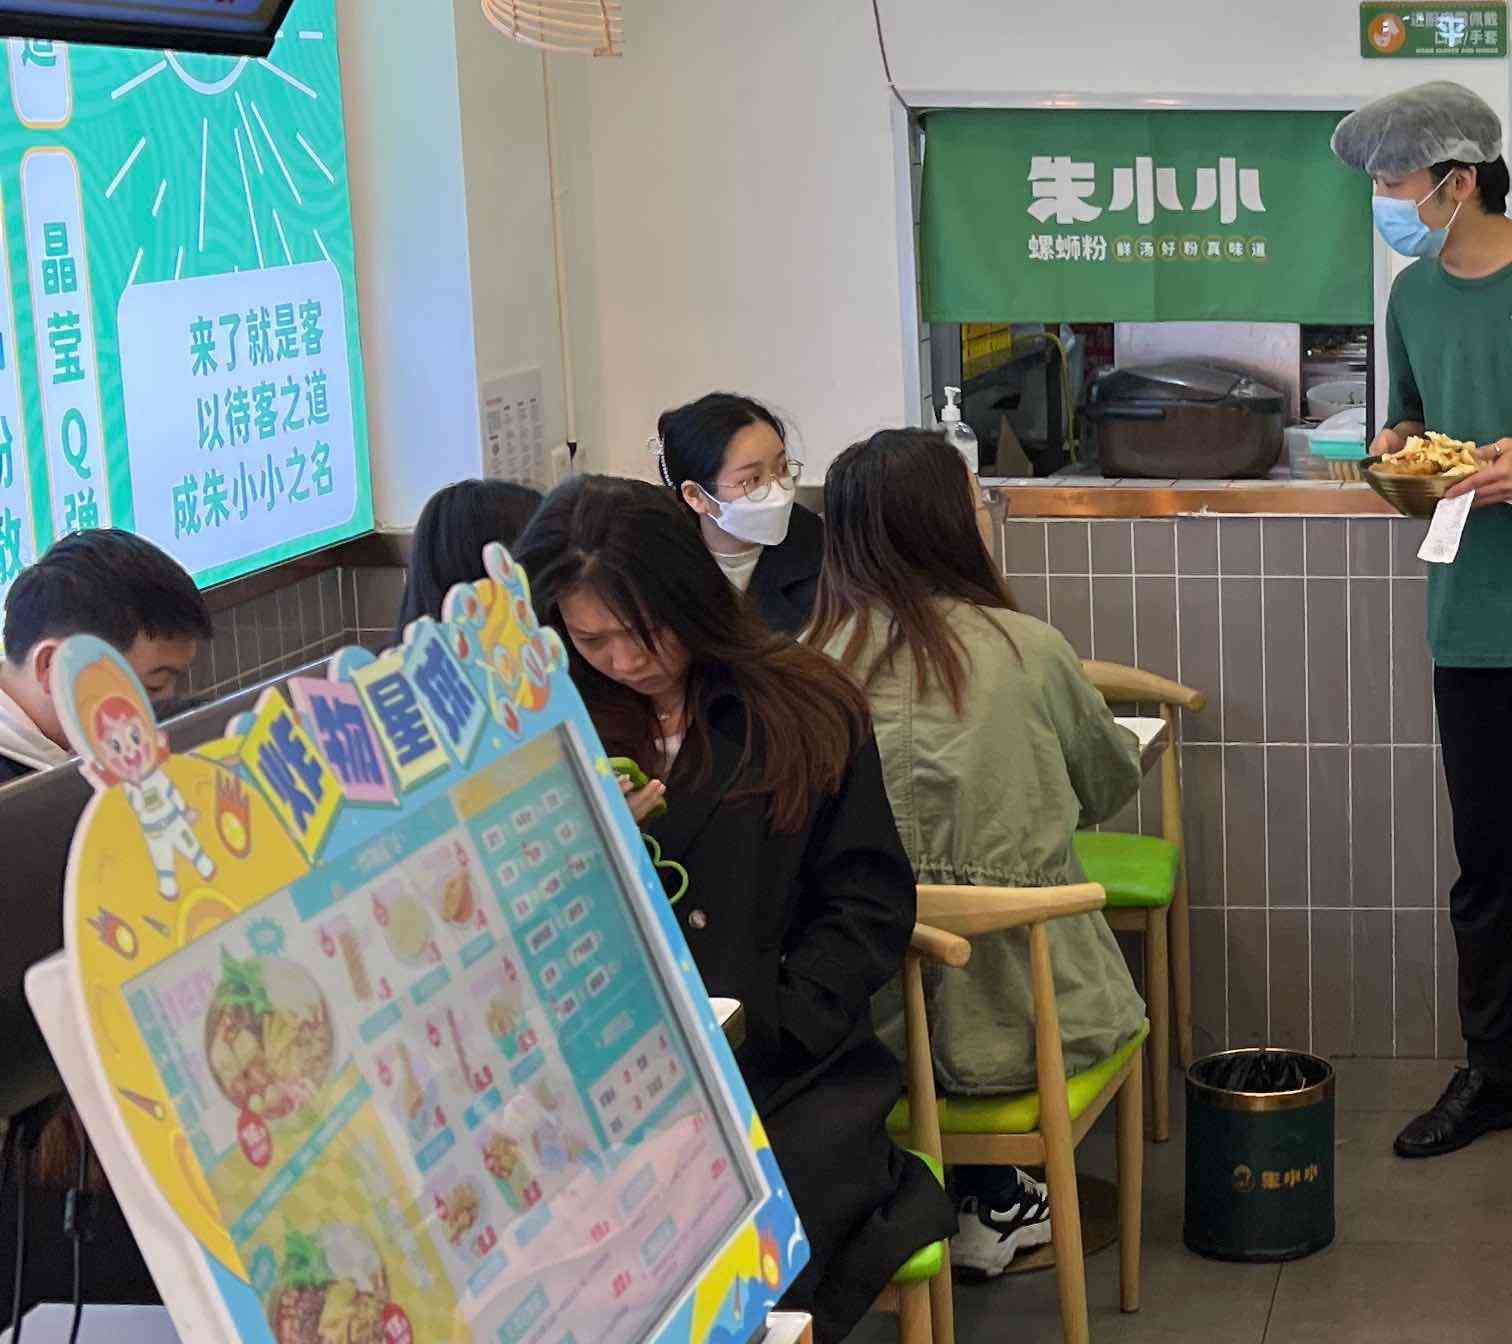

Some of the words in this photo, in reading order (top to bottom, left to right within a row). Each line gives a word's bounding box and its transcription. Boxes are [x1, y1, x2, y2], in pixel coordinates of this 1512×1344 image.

[1027, 156, 1266, 224] 朱小小
[1028, 234, 1106, 262] 螺蛳粉
[1116, 240, 1266, 258] 鲜汤好粉真味道
[189, 299, 324, 377] 来了就是客
[196, 368, 331, 452] 以待客之道
[171, 438, 335, 539] 成朱小小之名
